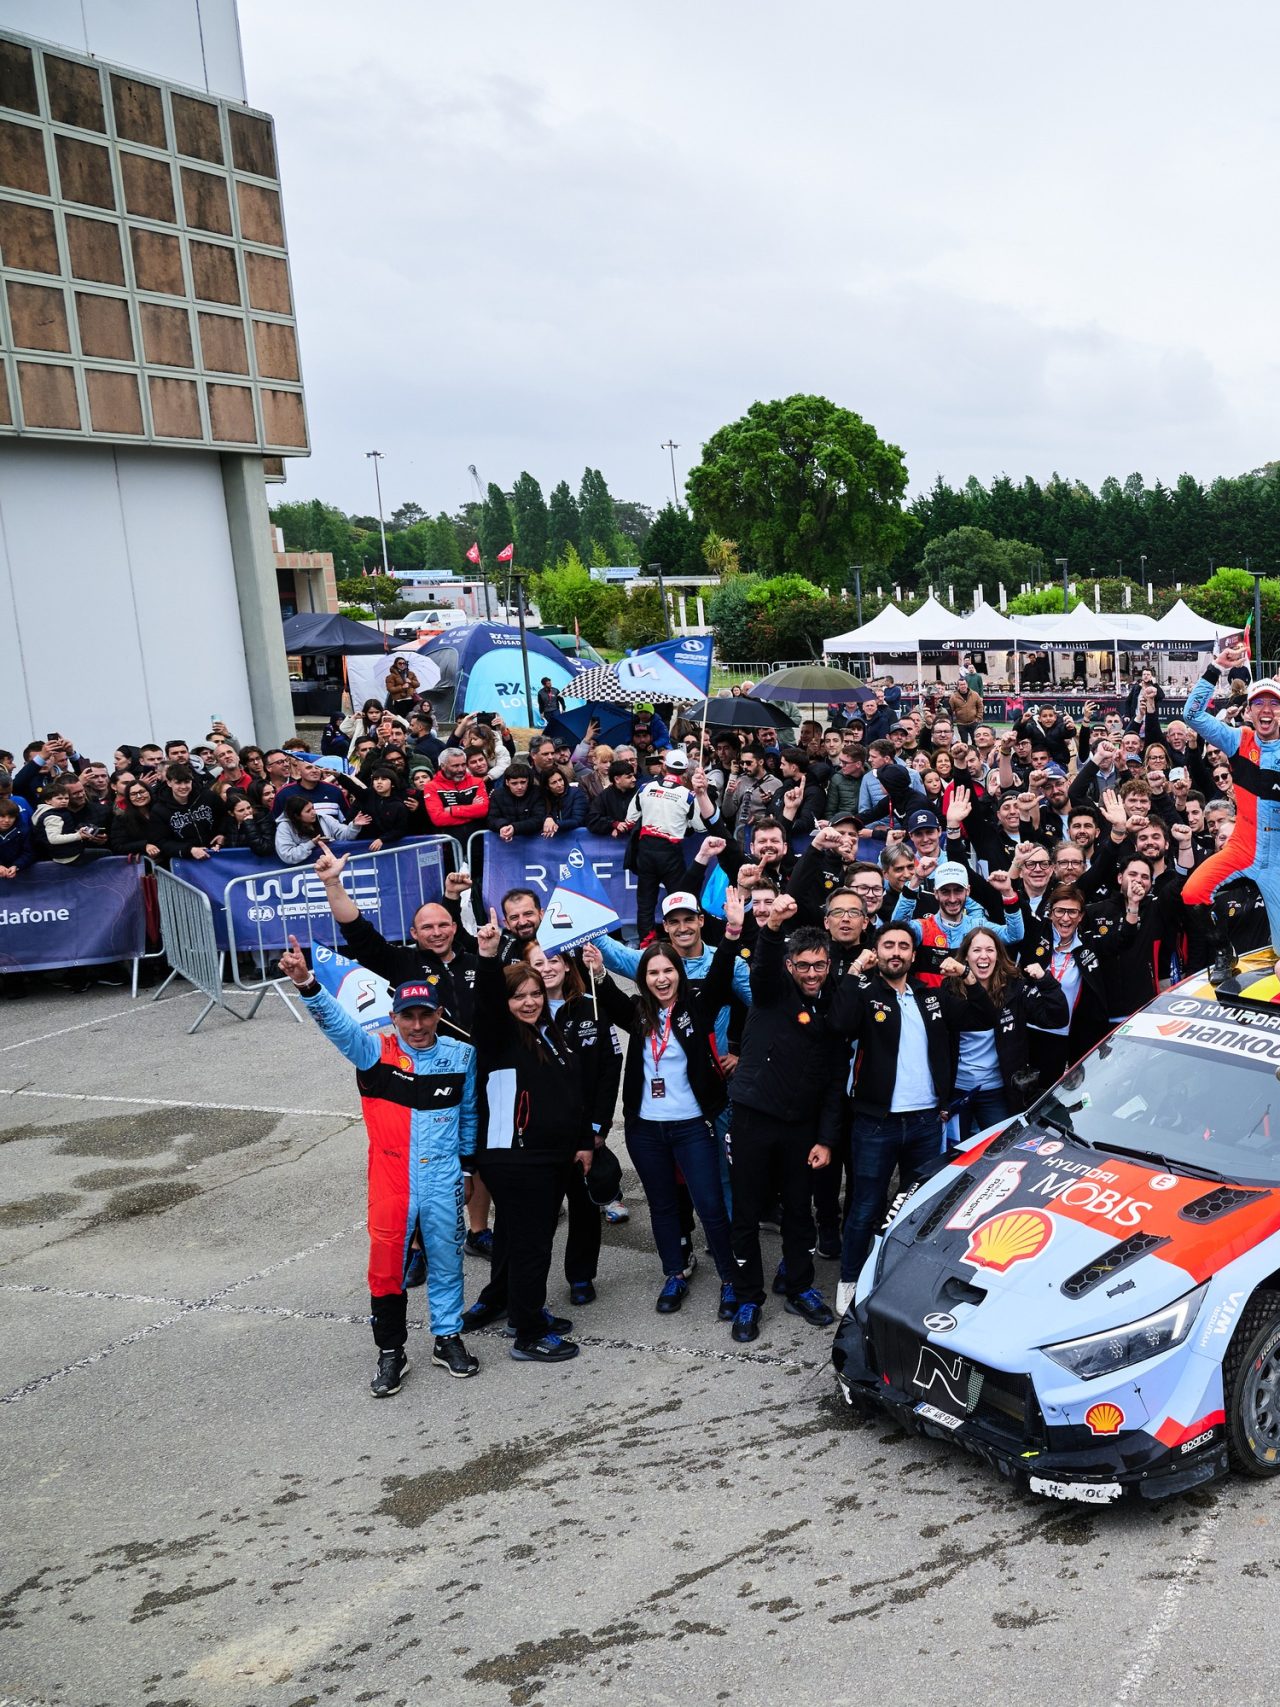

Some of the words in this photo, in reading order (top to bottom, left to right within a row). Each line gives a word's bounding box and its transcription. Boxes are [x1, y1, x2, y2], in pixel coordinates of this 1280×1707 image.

[967, 641, 990, 649] DIECAST
[1168, 642, 1192, 650] DIECAST
[984, 705, 1002, 715] CAST
[1158, 705, 1184, 716] DIECAS
[246, 868, 380, 902] WRC
[249, 907, 275, 921] FIA
[297, 902, 330, 913] WORL
[559, 928, 609, 953] #HMSGOfficial
[1042, 1157, 1119, 1184] HYUNDAI
[1028, 1172, 1152, 1226] MOBIS
[1213, 1291, 1245, 1337] WIA
[1200, 1305, 1222, 1348] HYUNDAI
[944, 1415, 959, 1427] 910
[1181, 1429, 1214, 1454] sparco
